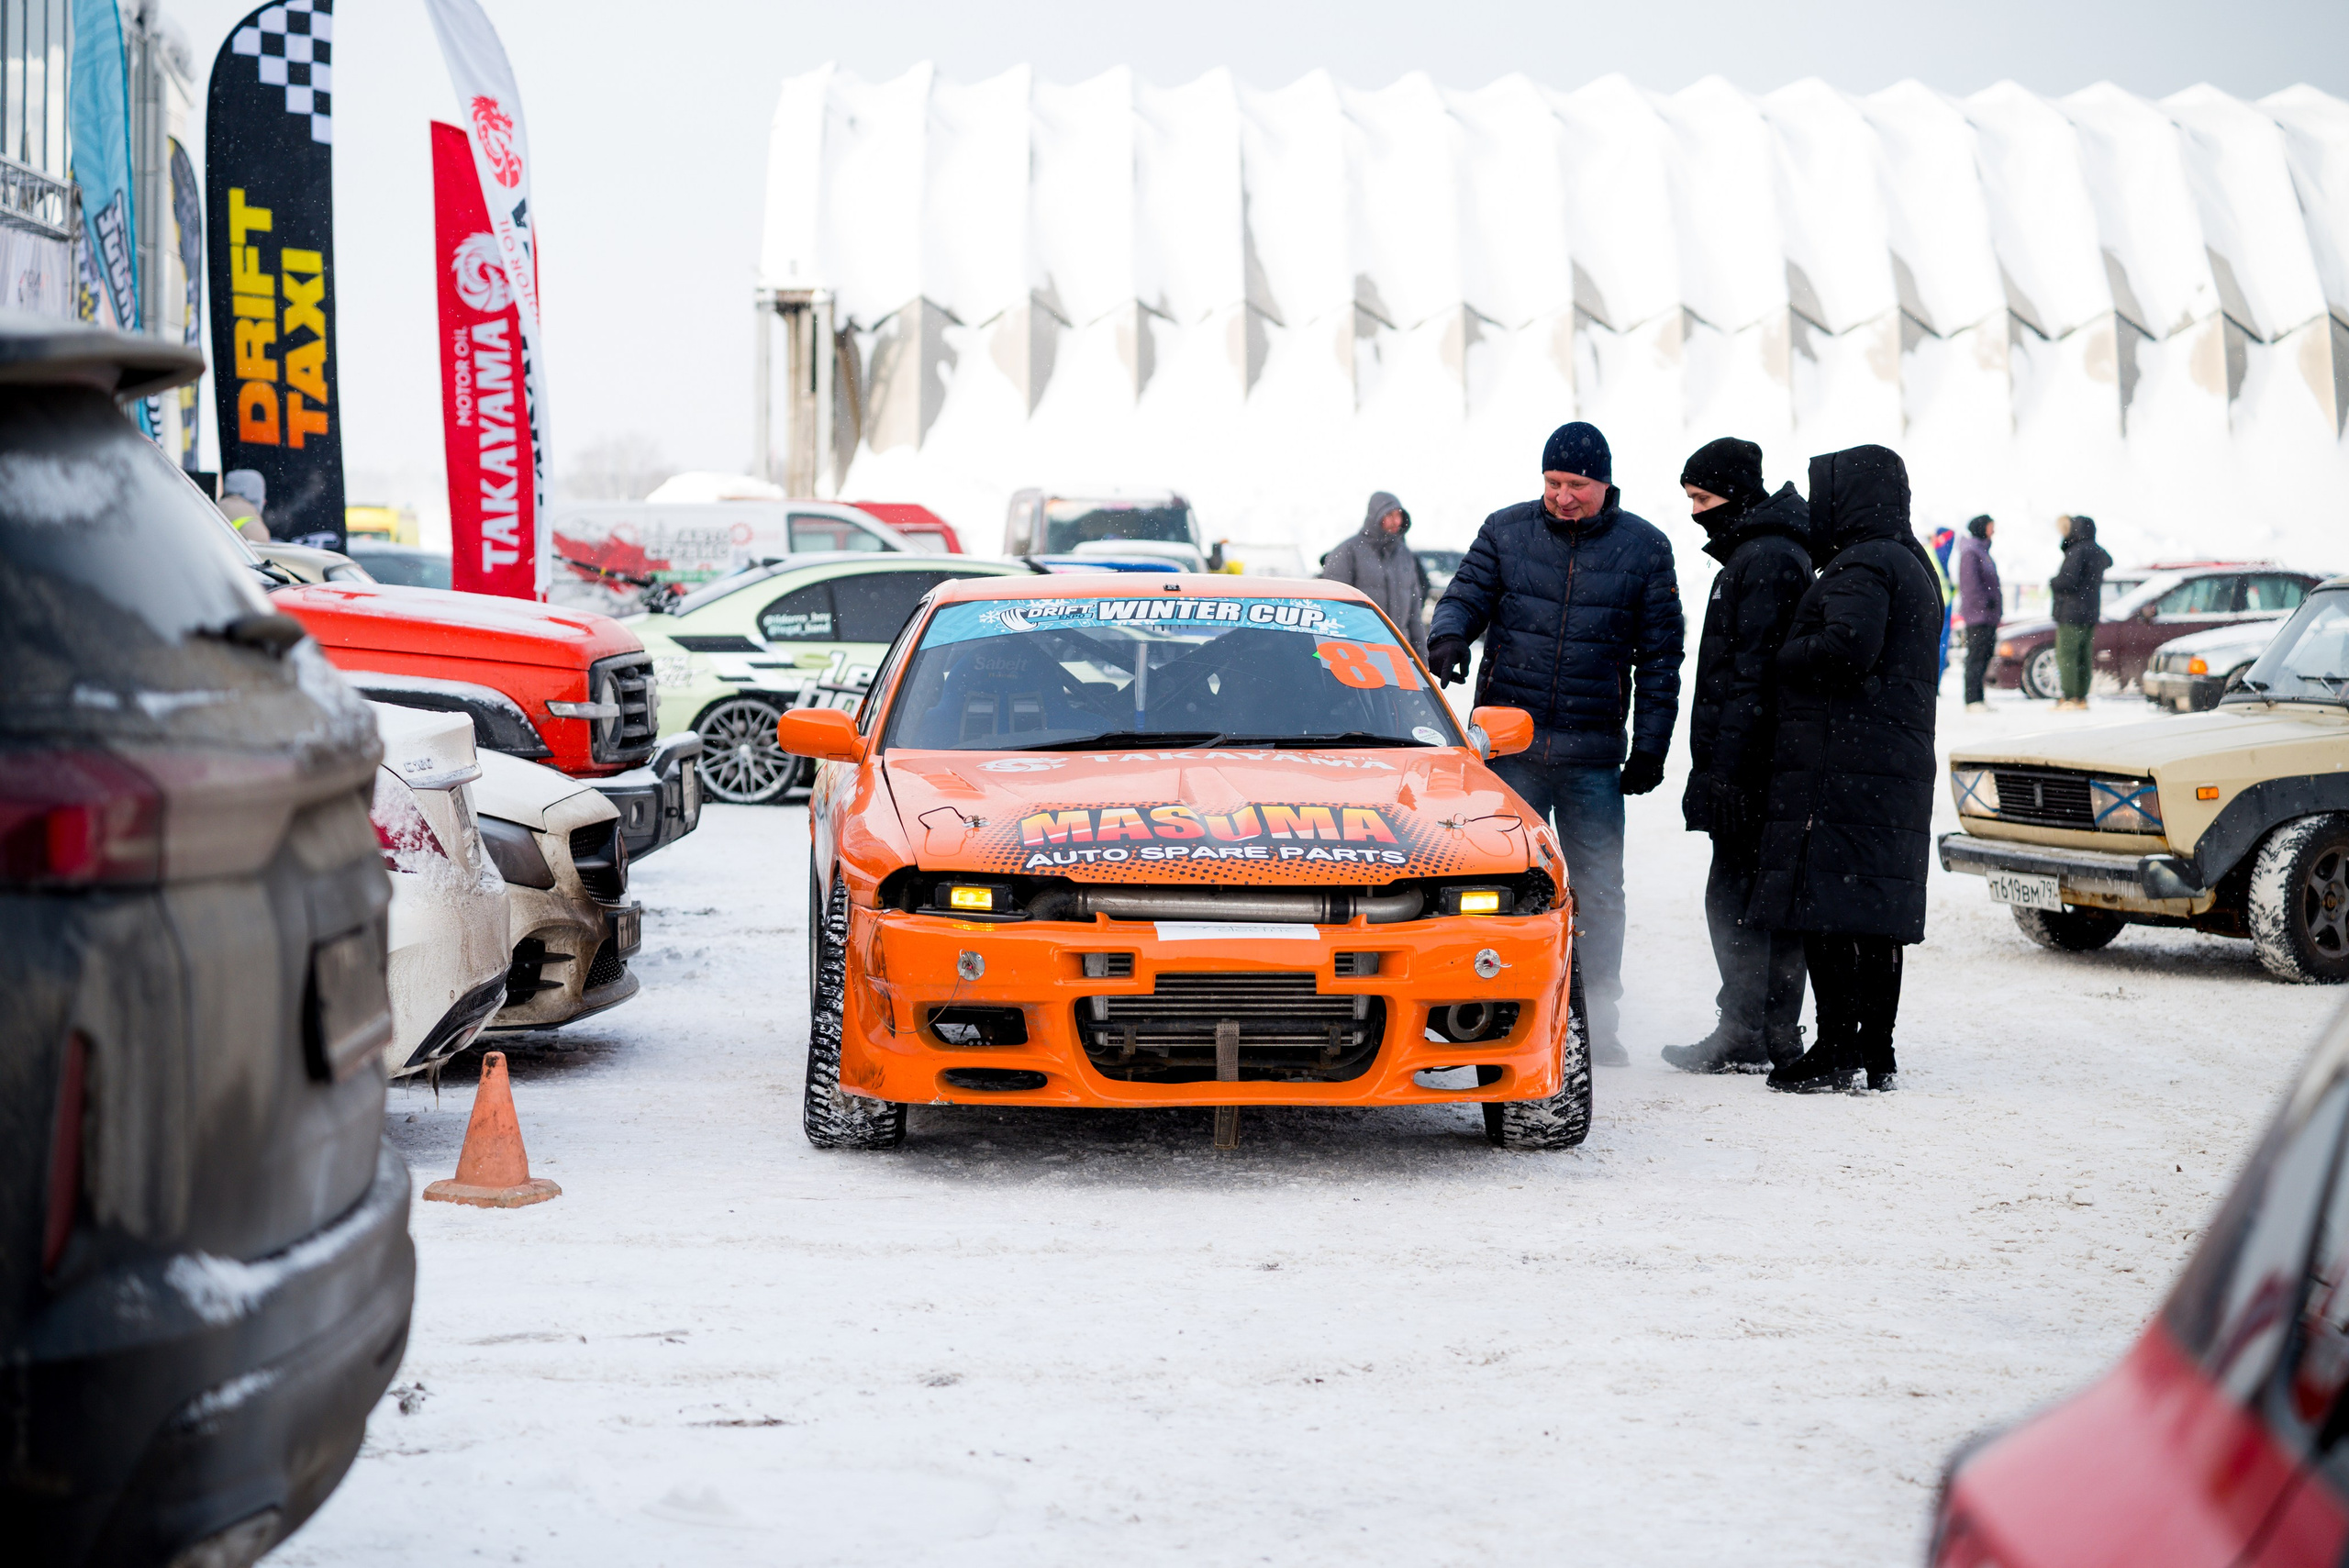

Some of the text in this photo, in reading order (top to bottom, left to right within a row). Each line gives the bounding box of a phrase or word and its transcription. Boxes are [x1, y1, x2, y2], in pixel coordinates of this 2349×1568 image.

[228, 187, 281, 446] DRIFT
[282, 247, 329, 449] TAXI
[453, 327, 473, 427] MOTOR OIL
[472, 317, 520, 573] TAKAYAMA
[1028, 605, 1095, 618] DRIFT
[1099, 600, 1325, 628] WINTER CUP
[974, 655, 1029, 672] Sabelt
[1083, 751, 1397, 771] TAKAYAMA
[1020, 805, 1399, 845] MASUMA
[1025, 846, 1407, 869] AUTO SPARE PARTS
